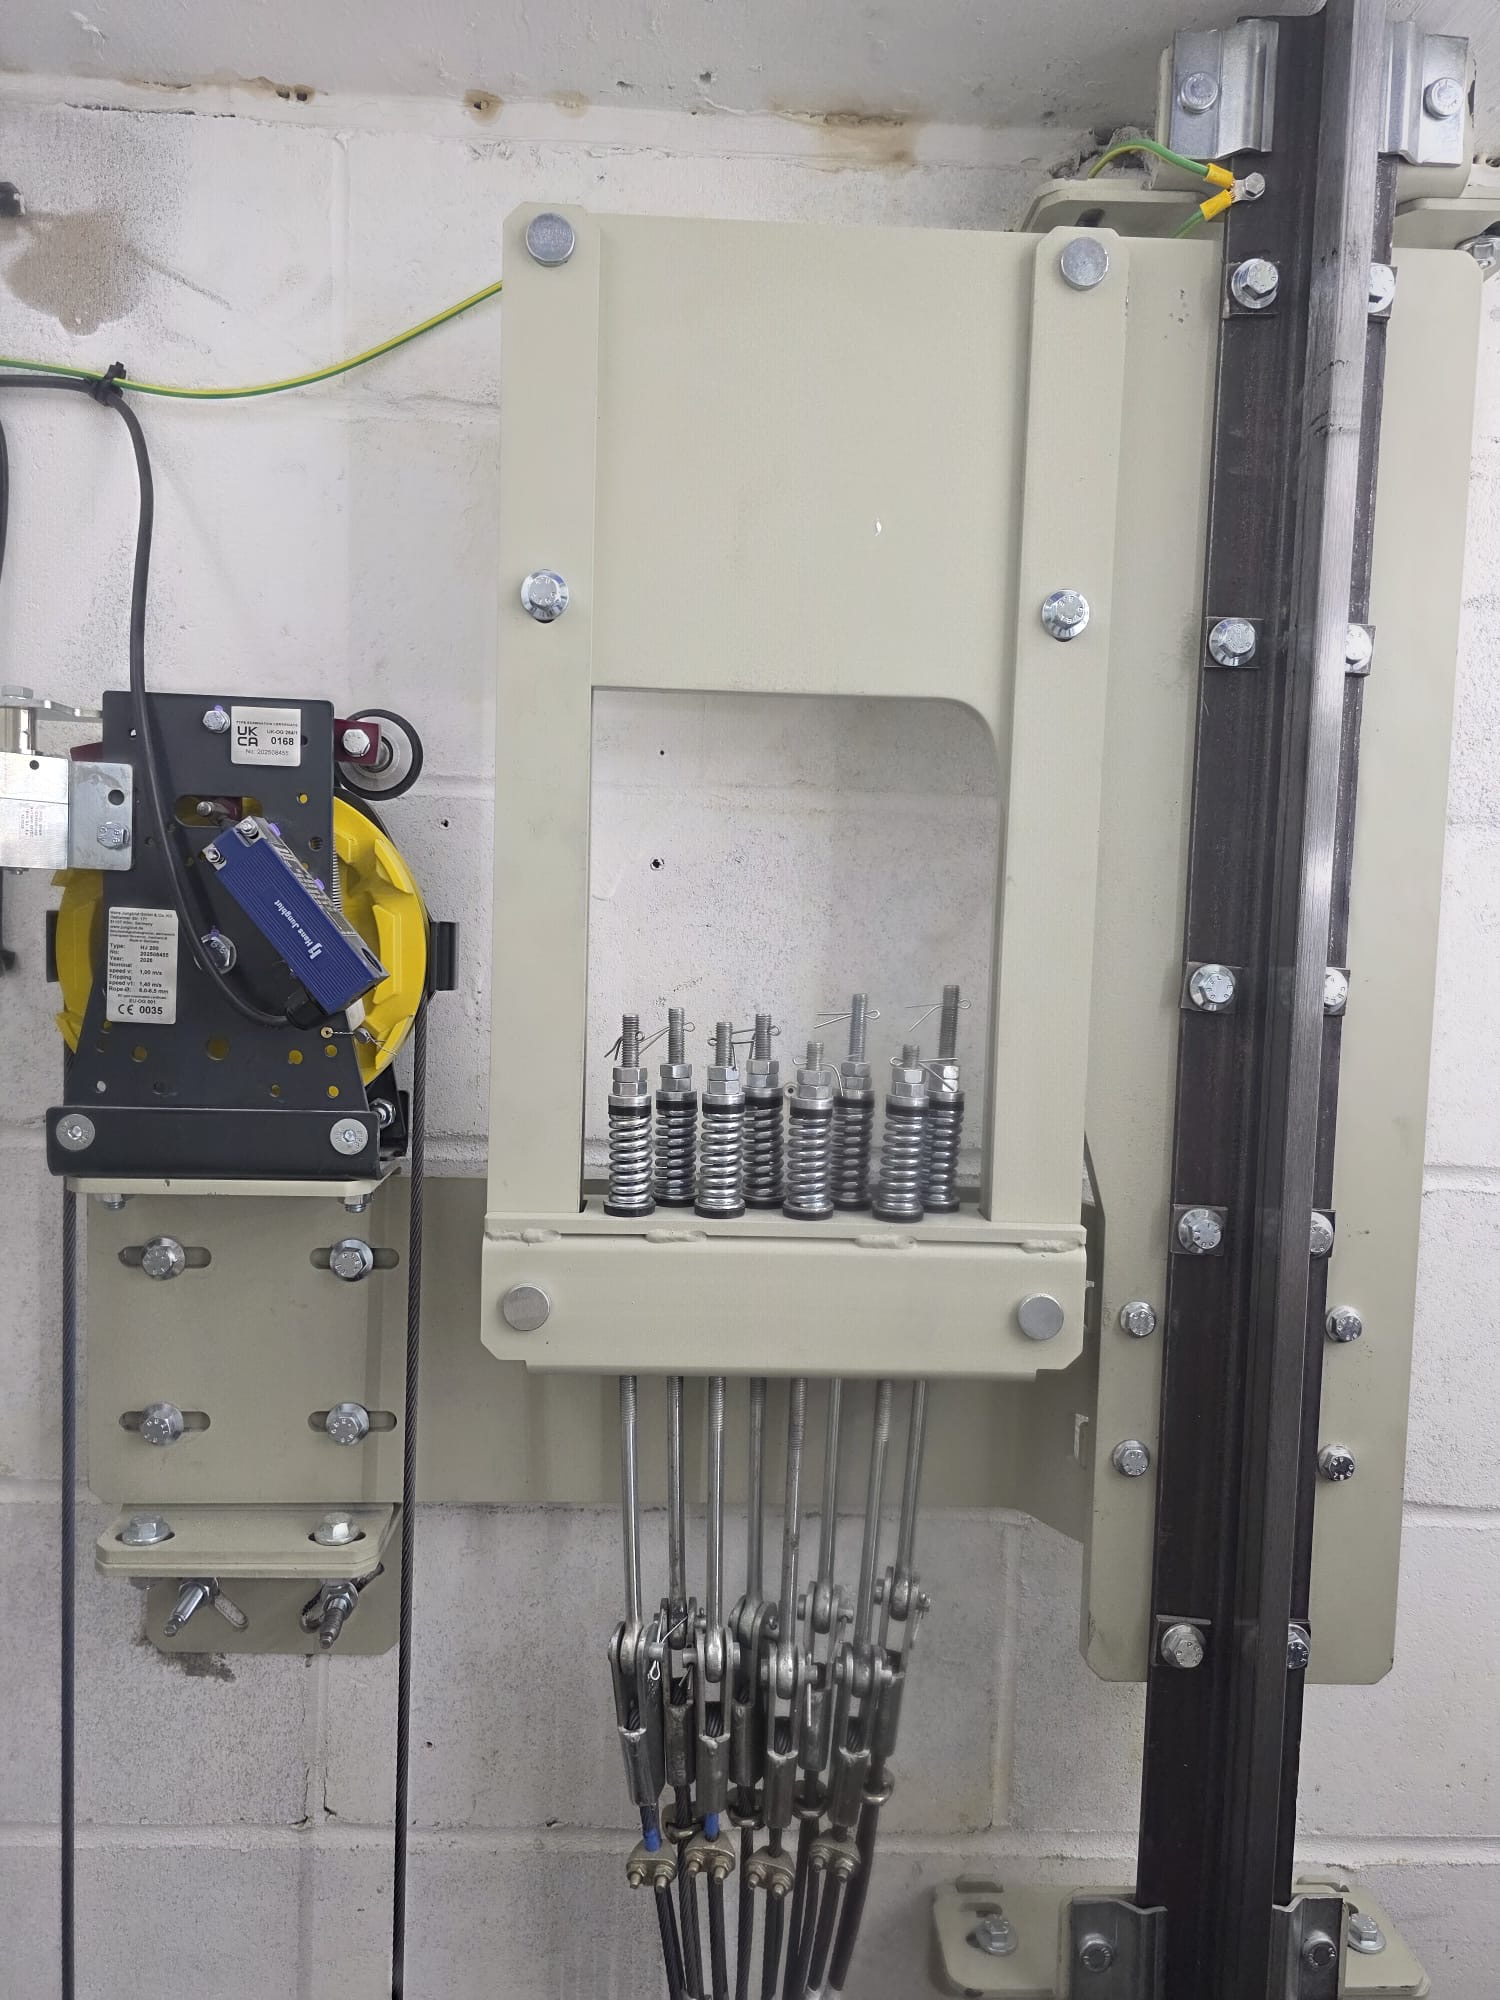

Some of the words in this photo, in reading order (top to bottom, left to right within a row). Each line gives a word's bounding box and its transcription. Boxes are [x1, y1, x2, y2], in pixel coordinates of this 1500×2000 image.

[237, 726, 258, 736] UK
[237, 736, 258, 747] CA
[271, 737, 294, 746] 0168
[273, 899, 300, 929] Jungblut
[297, 928, 314, 947] Hans
[118, 1003, 134, 1015] CE
[139, 1005, 163, 1015] 0035
